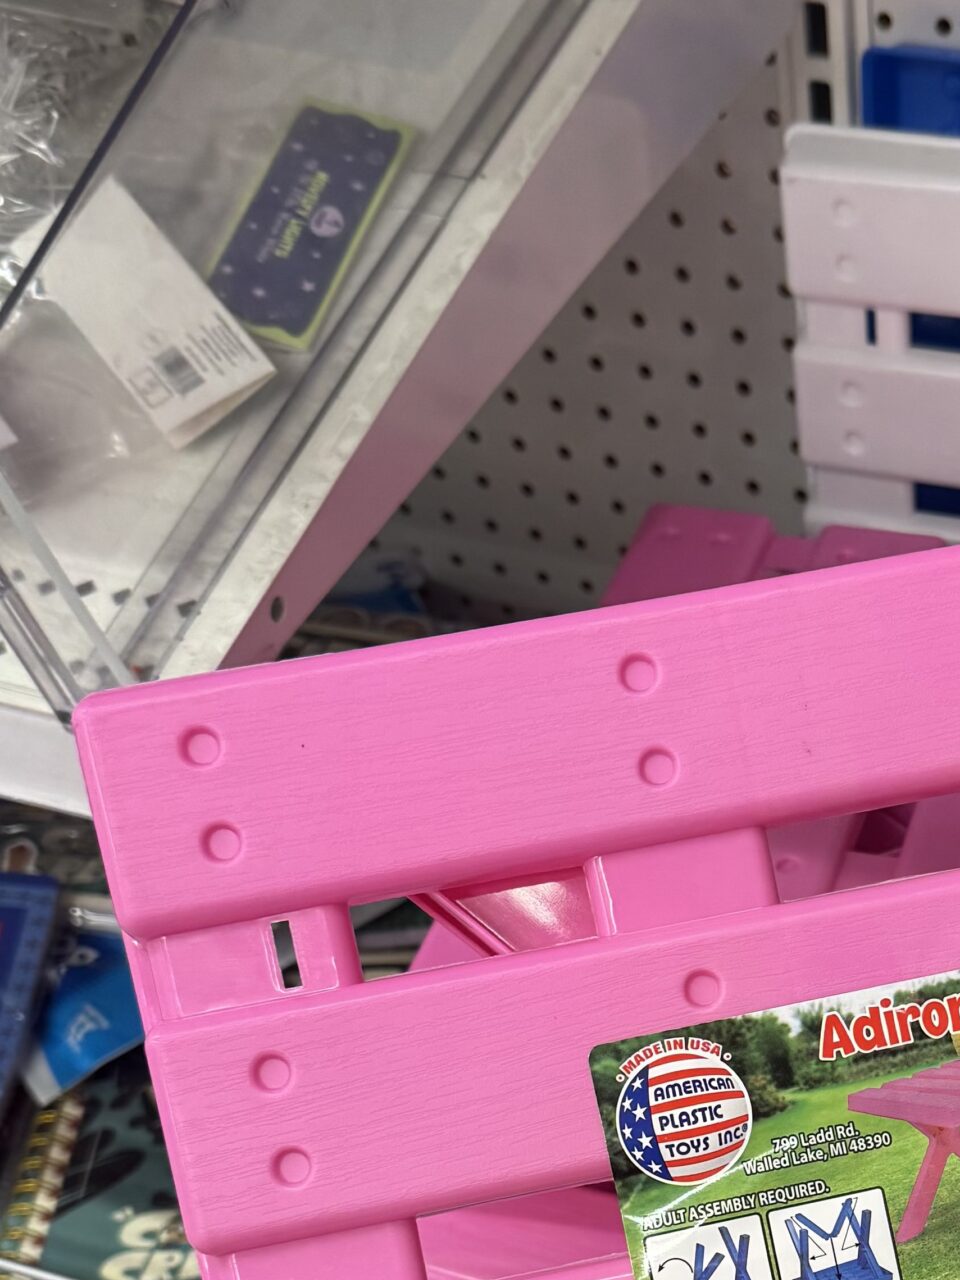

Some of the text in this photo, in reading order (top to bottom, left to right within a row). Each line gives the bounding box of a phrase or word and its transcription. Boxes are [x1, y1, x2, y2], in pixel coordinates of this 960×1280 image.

[622, 1038, 722, 1075] MADE IN USA
[654, 1077, 735, 1102] AMERICAN
[659, 1104, 724, 1131] PLASTIC
[665, 1137, 710, 1157] TOYS
[772, 1123, 860, 1153] 799 Ladd Rd.
[743, 1132, 892, 1176] Walled Lake, MI 48390
[643, 1180, 831, 1231] ADULT ASSEMBLY REQUIRED.
